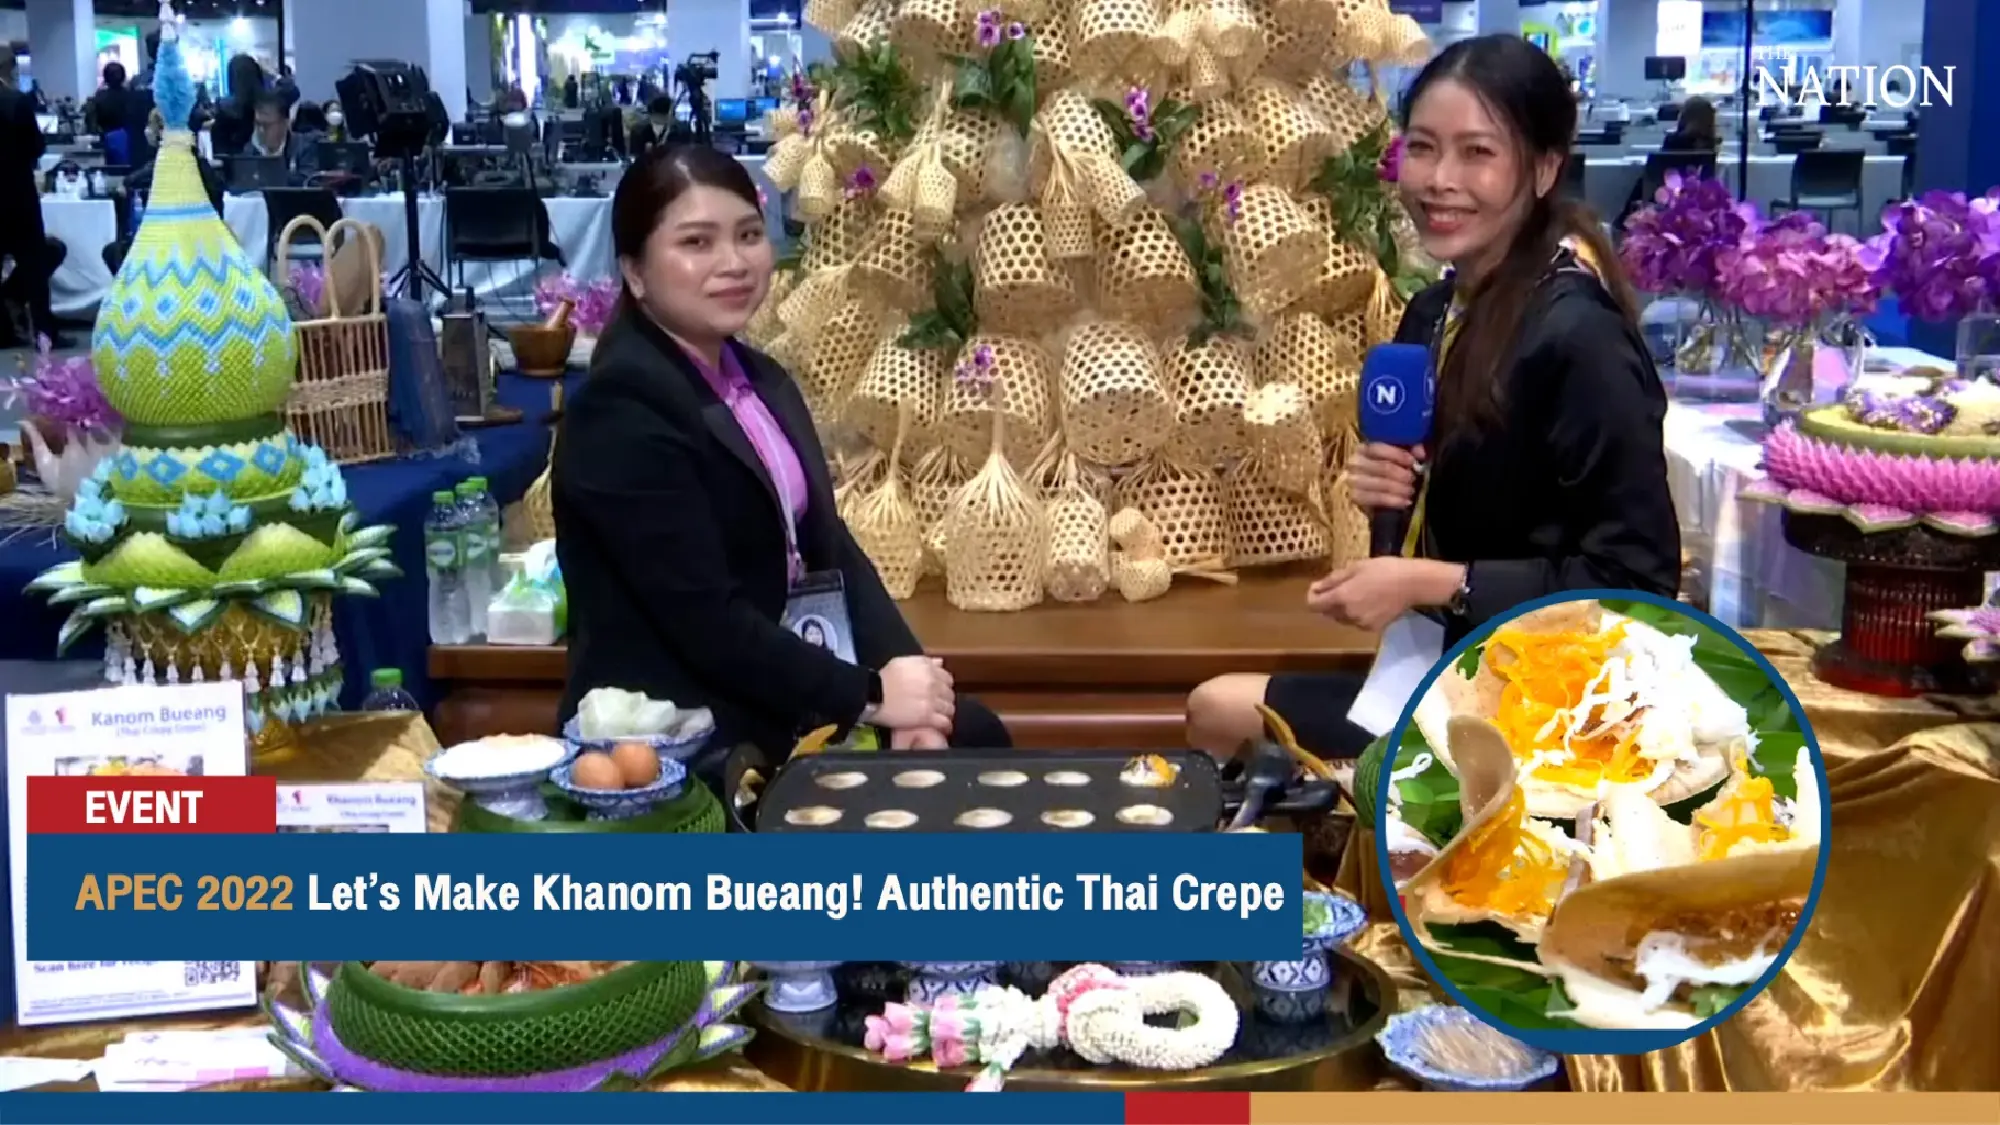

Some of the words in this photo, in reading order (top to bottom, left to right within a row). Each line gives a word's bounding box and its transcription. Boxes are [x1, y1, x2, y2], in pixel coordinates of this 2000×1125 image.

[1376, 382, 1397, 405] N
[91, 711, 155, 726] Kanom
[160, 705, 226, 722] Bueang
